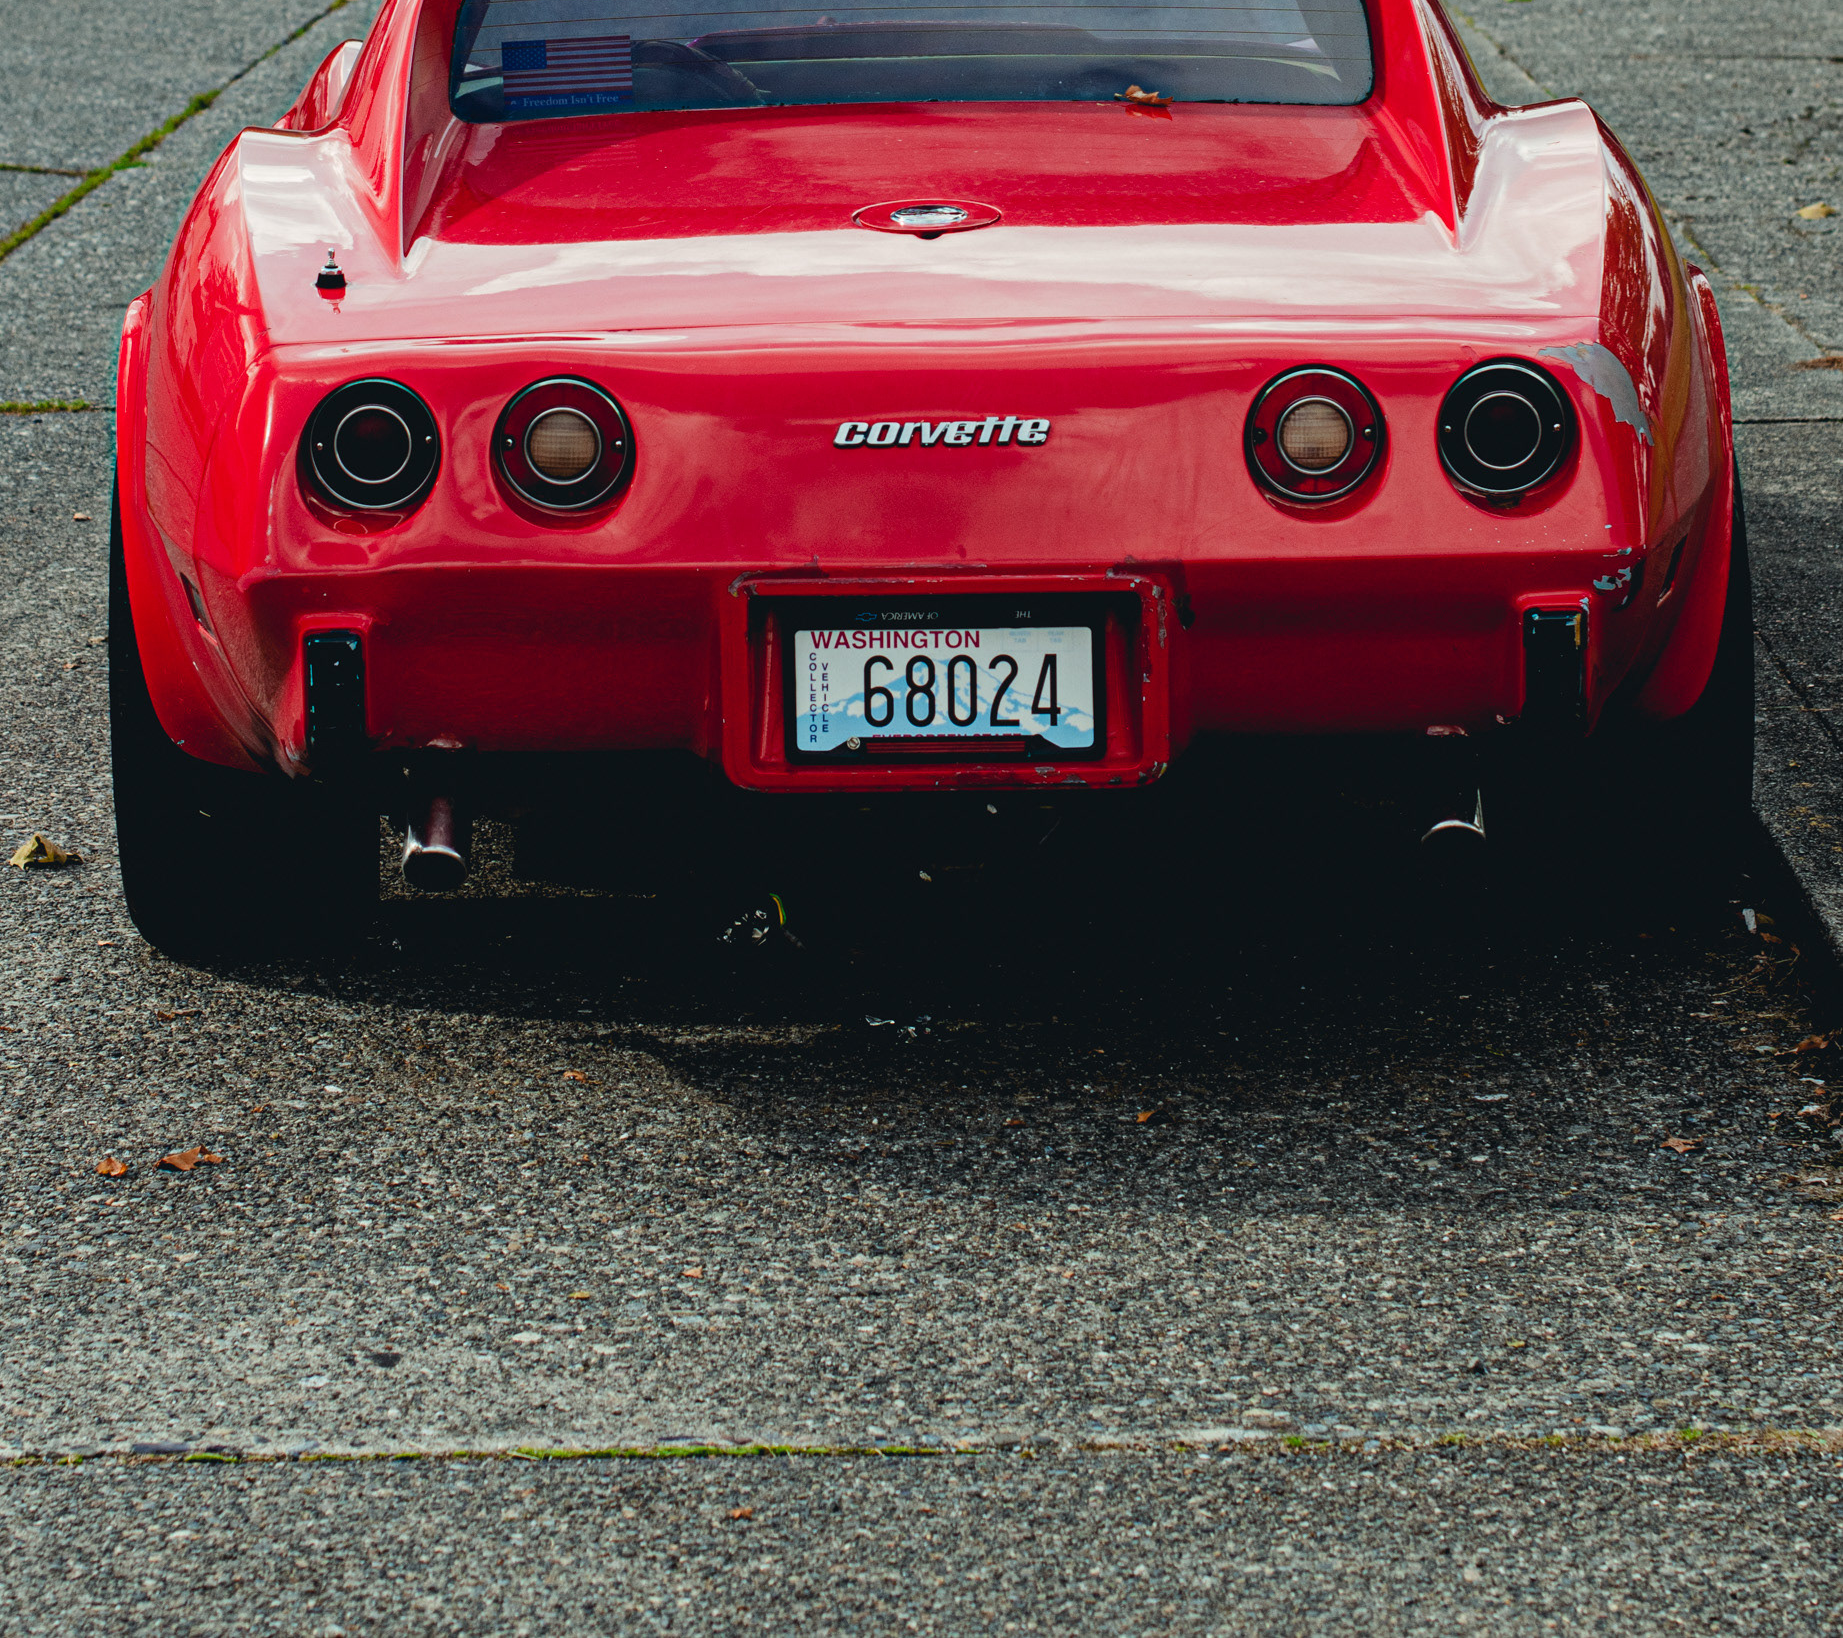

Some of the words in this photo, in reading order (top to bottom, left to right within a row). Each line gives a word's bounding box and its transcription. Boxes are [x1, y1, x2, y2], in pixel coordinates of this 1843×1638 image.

[523, 96, 568, 107] Freedom
[571, 94, 593, 105] Isn't
[596, 93, 619, 104] Free
[881, 611, 924, 620] AMERICA
[926, 611, 939, 620] OF
[1015, 610, 1032, 619] THE
[810, 630, 980, 649] WASHINGTON
[809, 652, 817, 743] COLLECTOR
[821, 662, 829, 733] VEHICLE
[863, 653, 1061, 728] 68024
